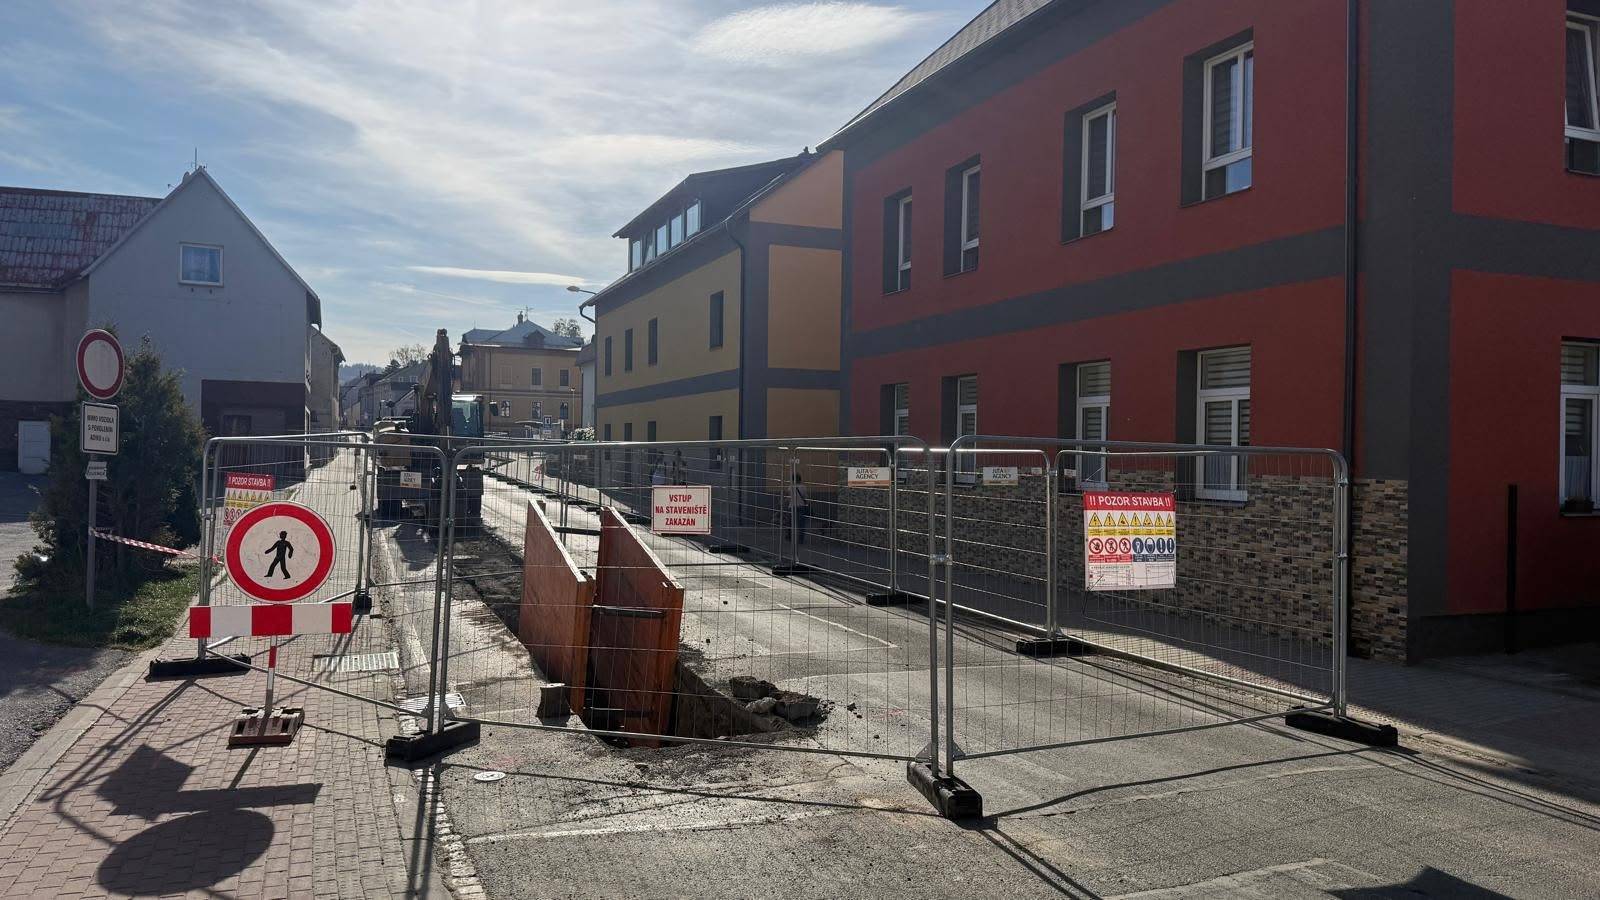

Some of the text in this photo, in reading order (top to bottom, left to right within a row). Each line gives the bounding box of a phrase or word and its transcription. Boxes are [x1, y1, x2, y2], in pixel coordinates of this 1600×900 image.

[232, 477, 248, 485] POZOR
[248, 477, 267, 487] STAVBA
[669, 494, 692, 503] VSTUP
[1098, 496, 1131, 506] POZOR
[1131, 496, 1164, 507] STAVBA
[655, 504, 707, 515] NA STAVENIŠTĚ
